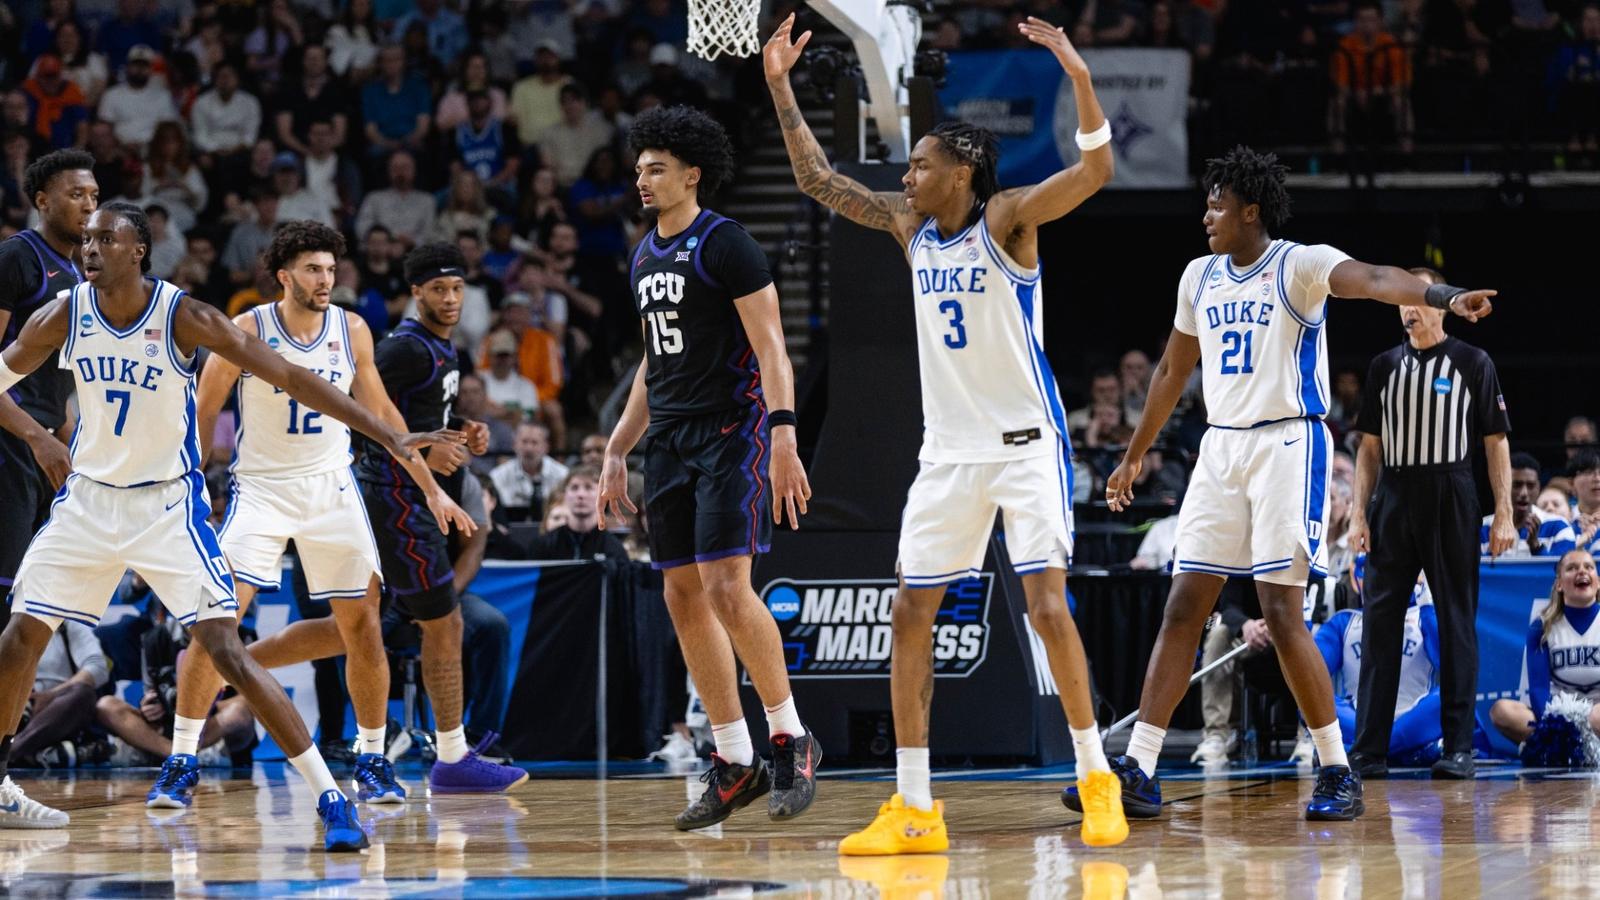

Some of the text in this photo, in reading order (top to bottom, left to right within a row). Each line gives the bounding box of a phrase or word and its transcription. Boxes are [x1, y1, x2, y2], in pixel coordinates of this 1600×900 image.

[638, 272, 685, 309] TCU
[917, 267, 987, 295] DUKE
[648, 310, 684, 355] 15
[939, 299, 967, 349] 3
[1206, 301, 1274, 329] DUKE
[1221, 330, 1253, 375] 21
[76, 356, 163, 391] DUKE
[106, 389, 131, 436] 7
[287, 399, 323, 434] 12
[1308, 520, 1322, 540] D
[771, 602, 799, 613] NCAA
[801, 588, 897, 624] MARC
[816, 625, 983, 661] MADSS
[1351, 639, 1417, 660] DE
[1552, 646, 1600, 669] DUK
[327, 791, 339, 803] D
